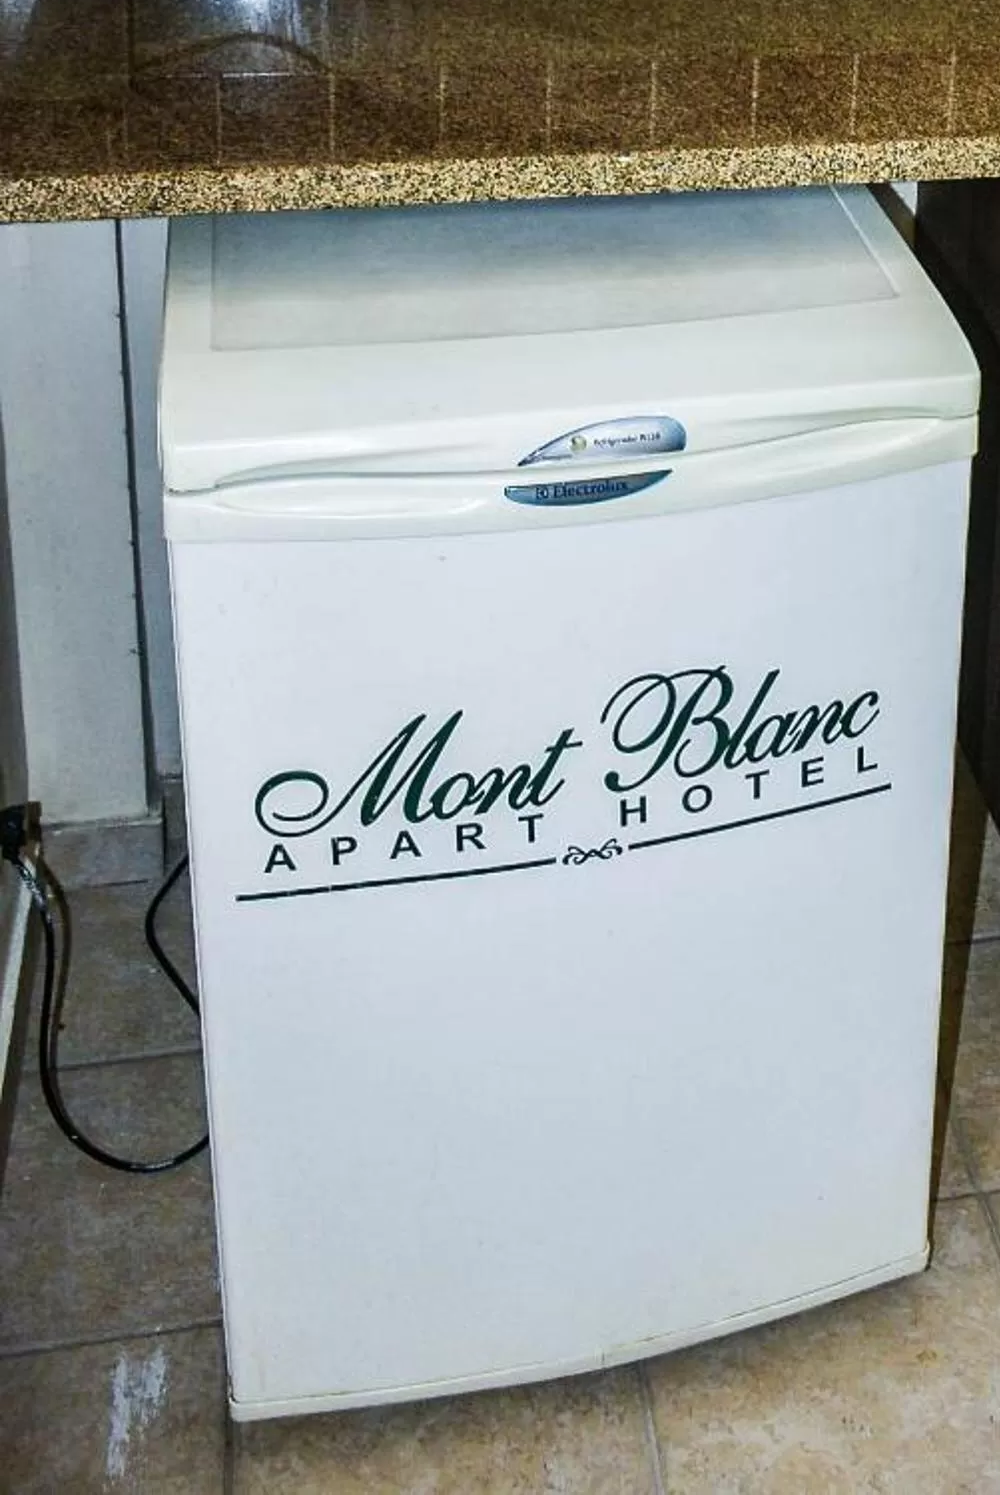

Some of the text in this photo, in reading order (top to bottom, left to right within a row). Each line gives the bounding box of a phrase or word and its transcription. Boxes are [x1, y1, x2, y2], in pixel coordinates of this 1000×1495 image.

[553, 480, 628, 499] Electrolux
[255, 665, 879, 837] Mont Blanc
[264, 747, 877, 873] APART HOTEL
